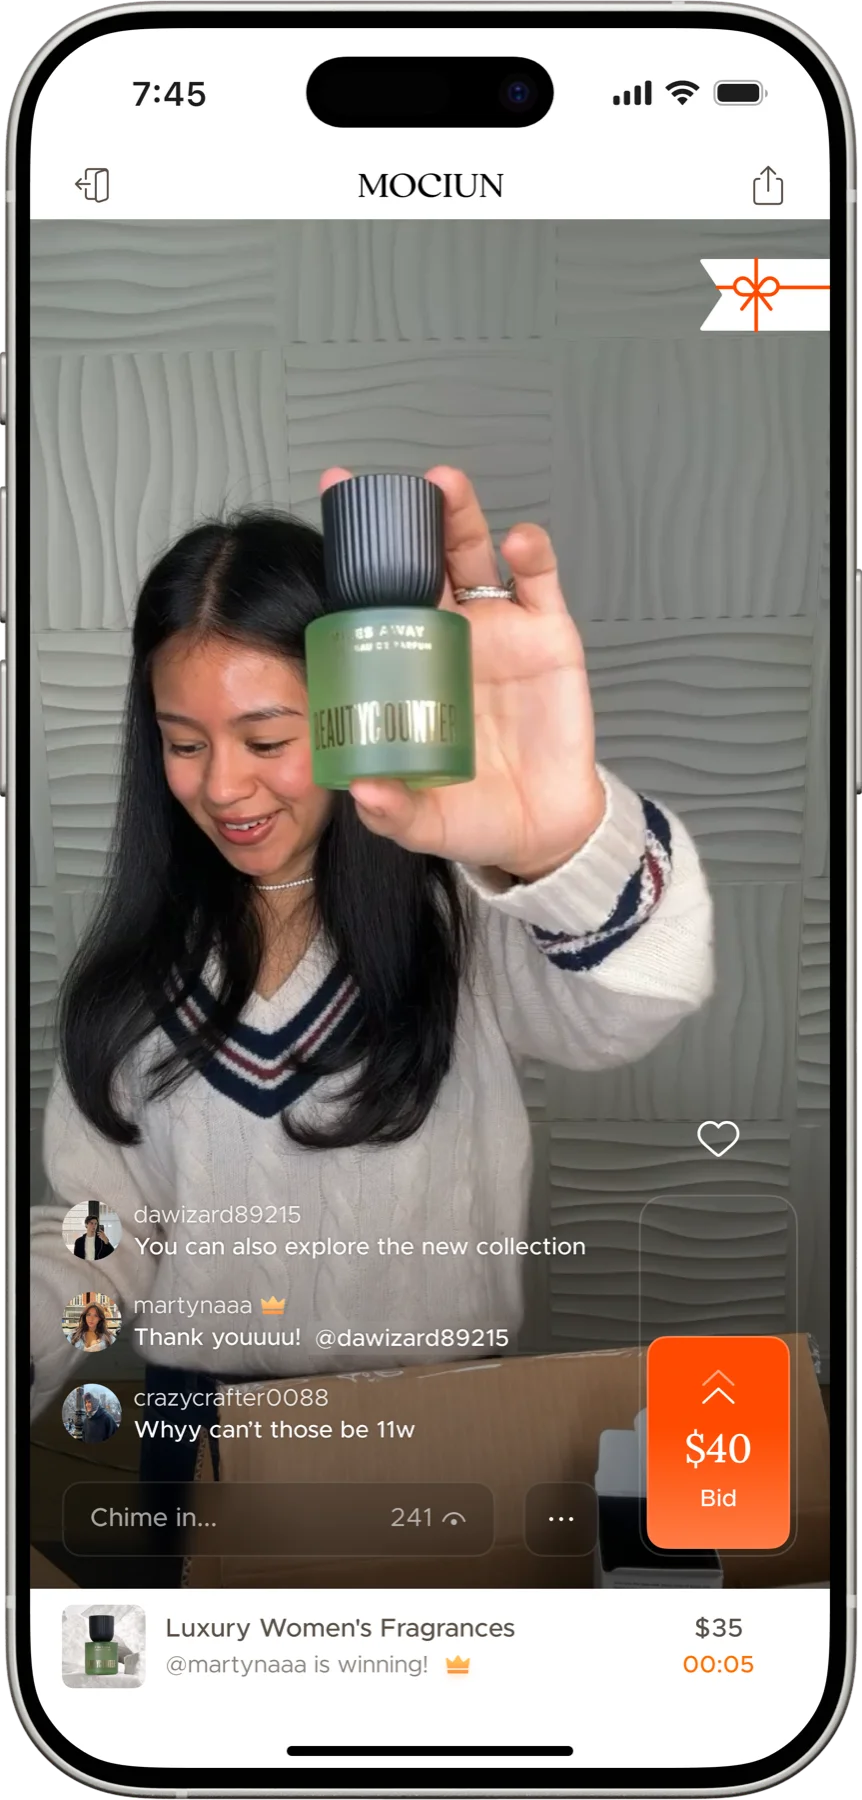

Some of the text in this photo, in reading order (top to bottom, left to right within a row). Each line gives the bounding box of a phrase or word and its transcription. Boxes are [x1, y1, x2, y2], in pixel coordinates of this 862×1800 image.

[132, 81, 206, 107] 7:45
[358, 172, 504, 198] MOCIUN
[134, 1205, 301, 1224] dawizard89215
[134, 1237, 585, 1259] You can also explore the new collection
[134, 1296, 252, 1318] martynaaa
[134, 1327, 509, 1350] Thank youuuu! @dawizard89215
[134, 1387, 328, 1411] crazycrafter0088
[134, 1420, 202, 1442] Whyy
[270, 1420, 333, 1439] those
[341, 1420, 369, 1439] be
[377, 1420, 415, 1438] 11w
[686, 1428, 751, 1469] $40
[701, 1488, 736, 1507] Bid
[90, 1507, 217, 1527] Chime in...
[391, 1507, 431, 1527] 241
[166, 1618, 515, 1642] Luxury Women's Fragrances
[695, 1616, 743, 1640] $35
[166, 1654, 428, 1678] @martynaaa is winning!
[682, 1654, 755, 1674] 00:05
